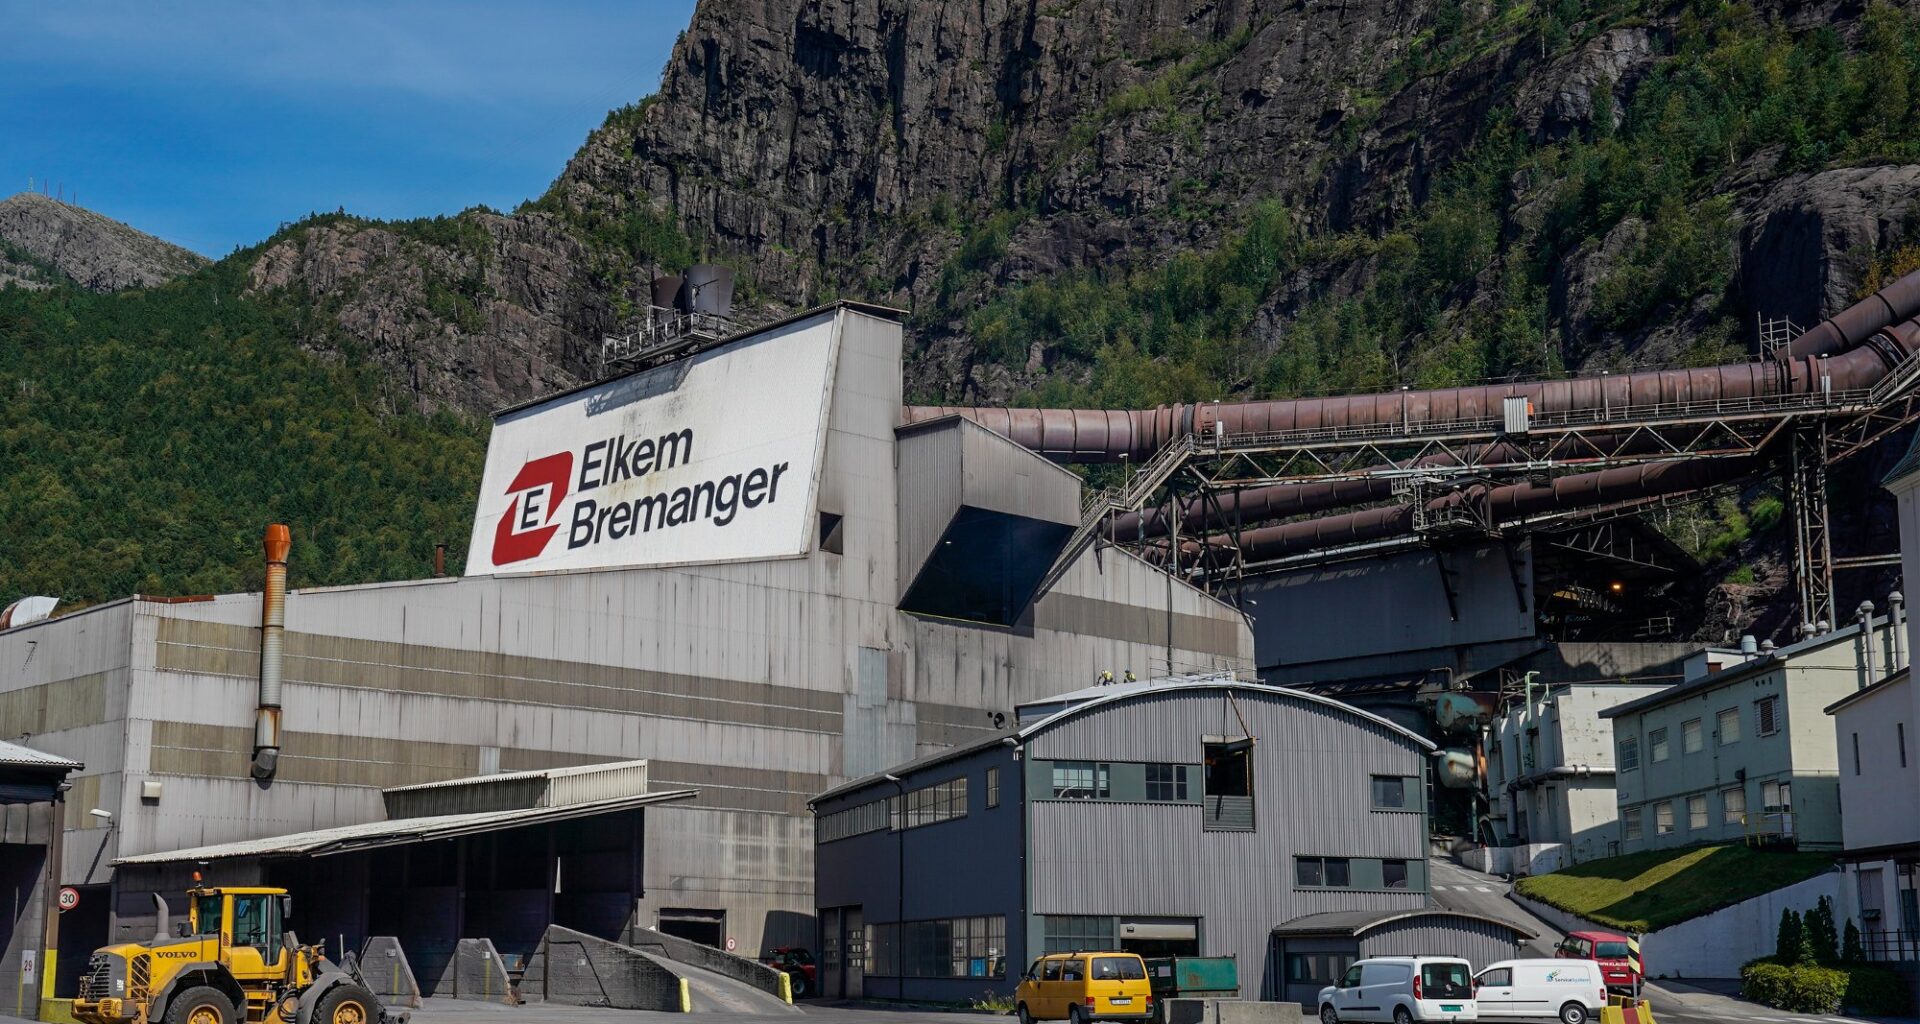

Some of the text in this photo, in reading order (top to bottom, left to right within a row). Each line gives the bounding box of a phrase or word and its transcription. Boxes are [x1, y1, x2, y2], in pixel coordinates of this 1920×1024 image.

[578, 427, 693, 492] Elkem
[520, 488, 544, 530] E
[567, 461, 789, 550] Bremanger
[62, 894, 75, 904] 30
[24, 960, 33, 971] 29
[156, 951, 197, 959] VOLVO
